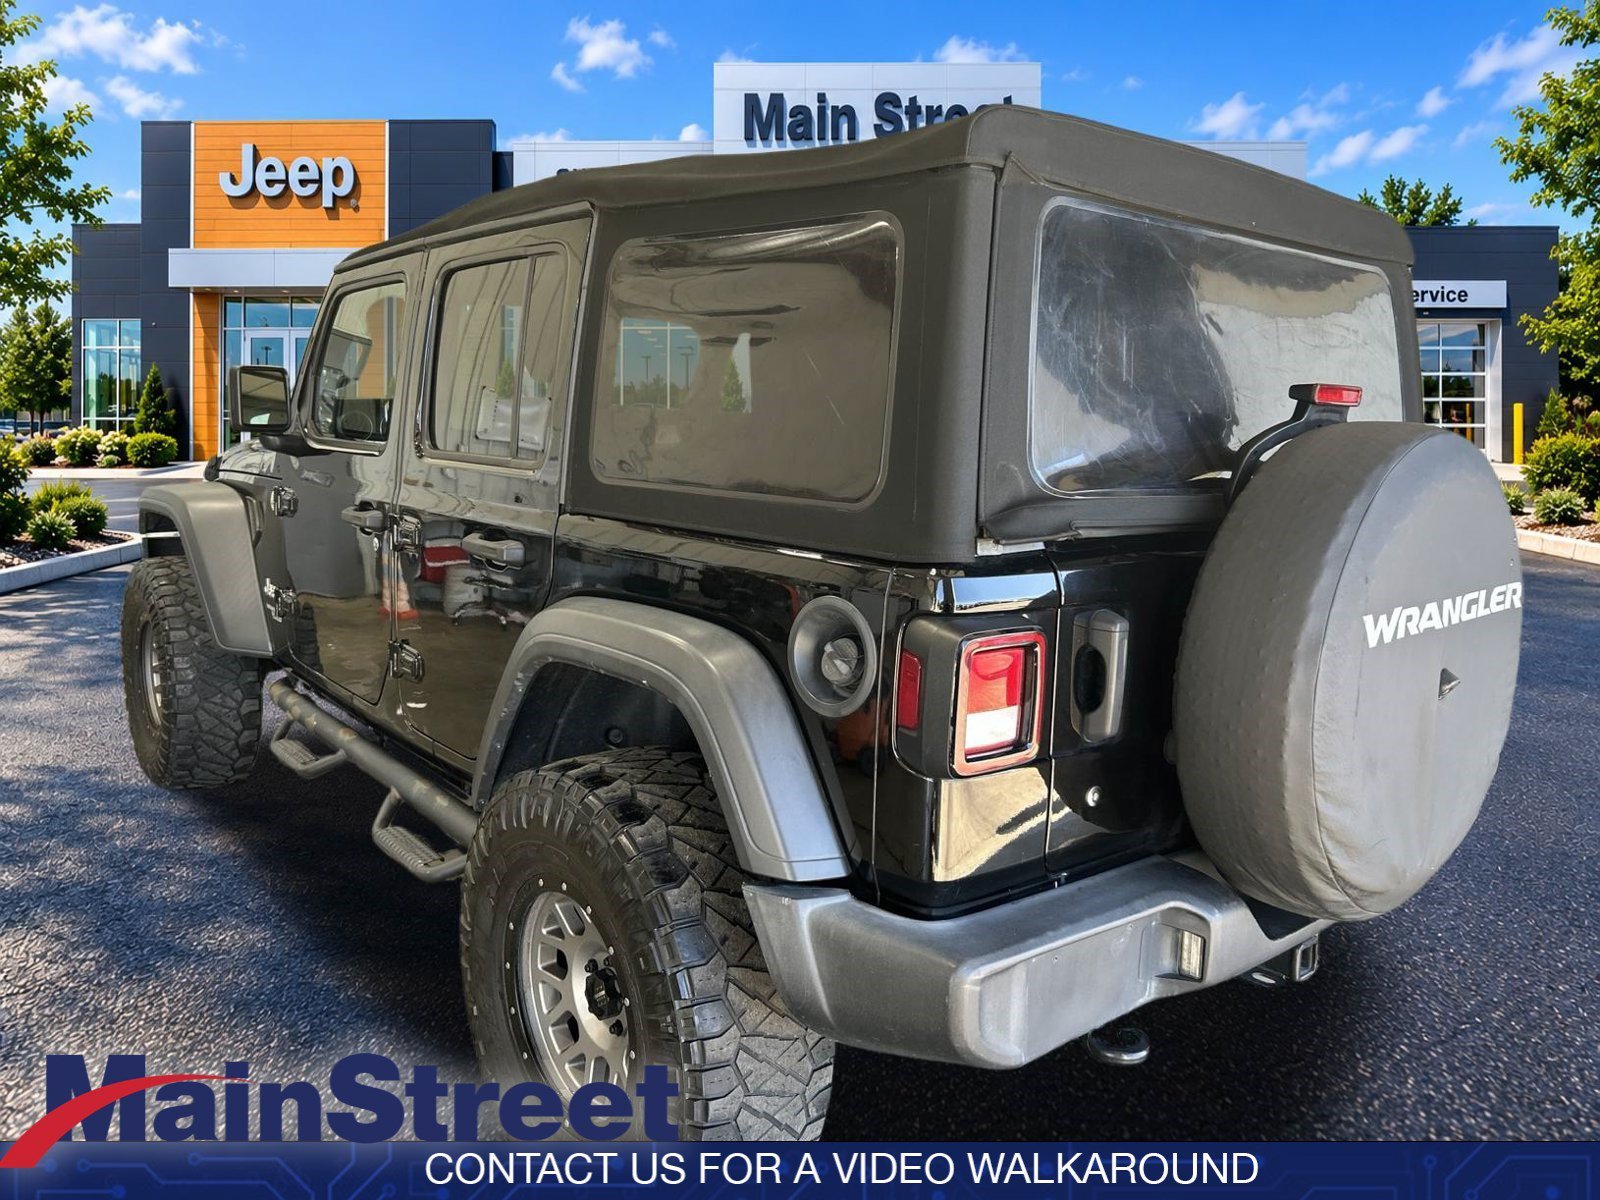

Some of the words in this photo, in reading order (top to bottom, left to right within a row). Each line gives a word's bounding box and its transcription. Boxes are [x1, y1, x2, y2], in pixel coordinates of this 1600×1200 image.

[743, 92, 856, 142] Main
[872, 91, 1013, 140] Str
[218, 143, 354, 208] Jeep
[1412, 285, 1469, 303] ervice
[1362, 581, 1523, 648] WRANGLER
